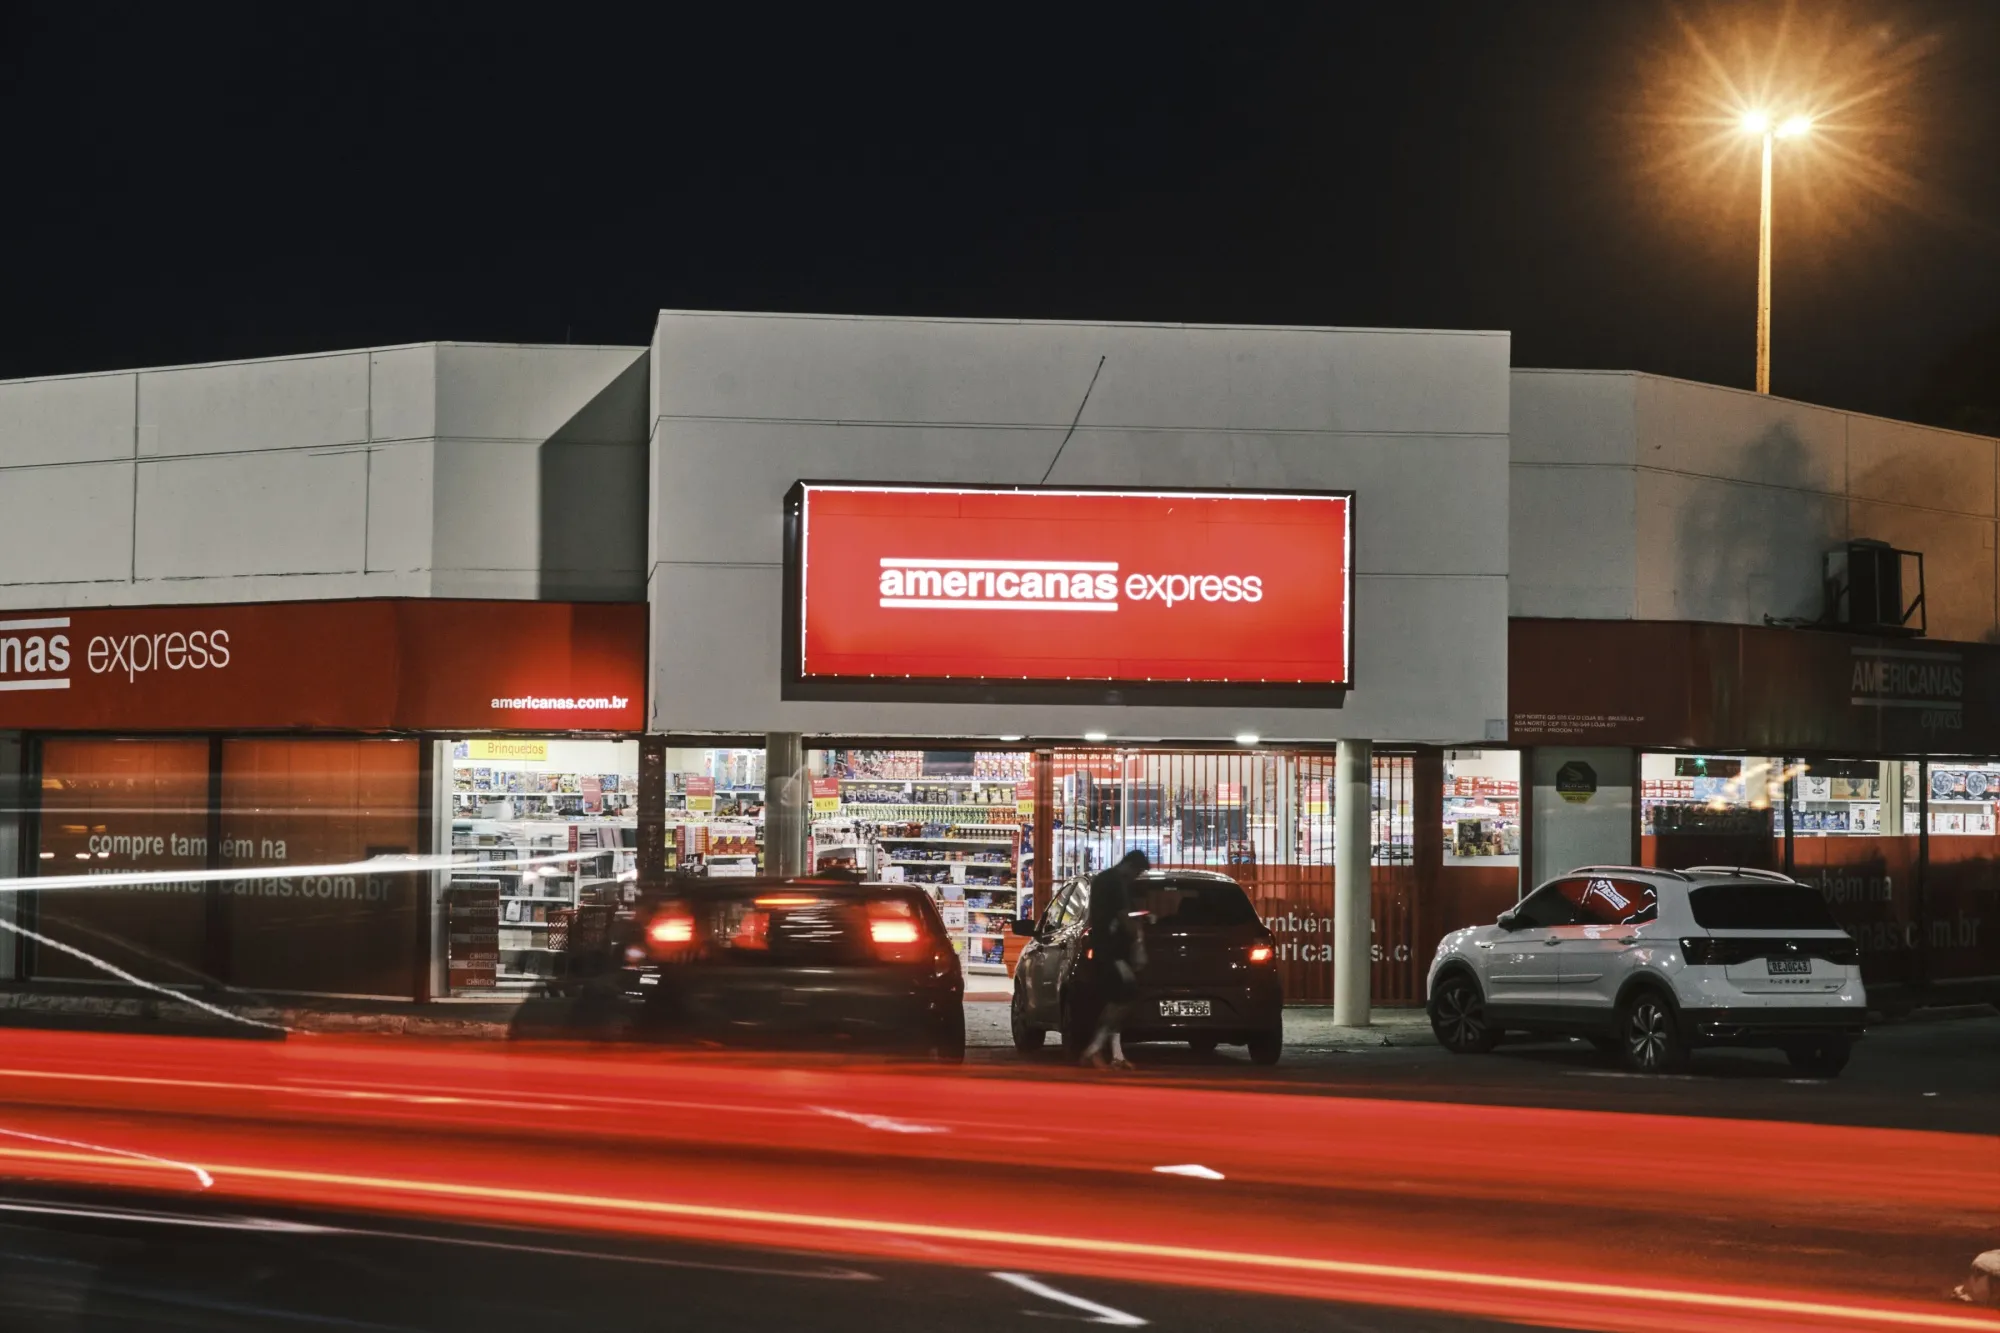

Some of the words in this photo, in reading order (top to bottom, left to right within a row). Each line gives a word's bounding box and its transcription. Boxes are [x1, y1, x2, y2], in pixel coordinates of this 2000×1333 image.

[880, 569, 1117, 599] americanas
[1126, 573, 1263, 607] express
[88, 629, 230, 683] express
[1852, 661, 1963, 697] AMERICANAS
[491, 696, 628, 709] americanas.com.br
[1921, 710, 1962, 740] express
[488, 743, 544, 755] Brinquedos
[89, 834, 164, 860] compre
[171, 832, 253, 859] tamém
[261, 837, 287, 859] na
